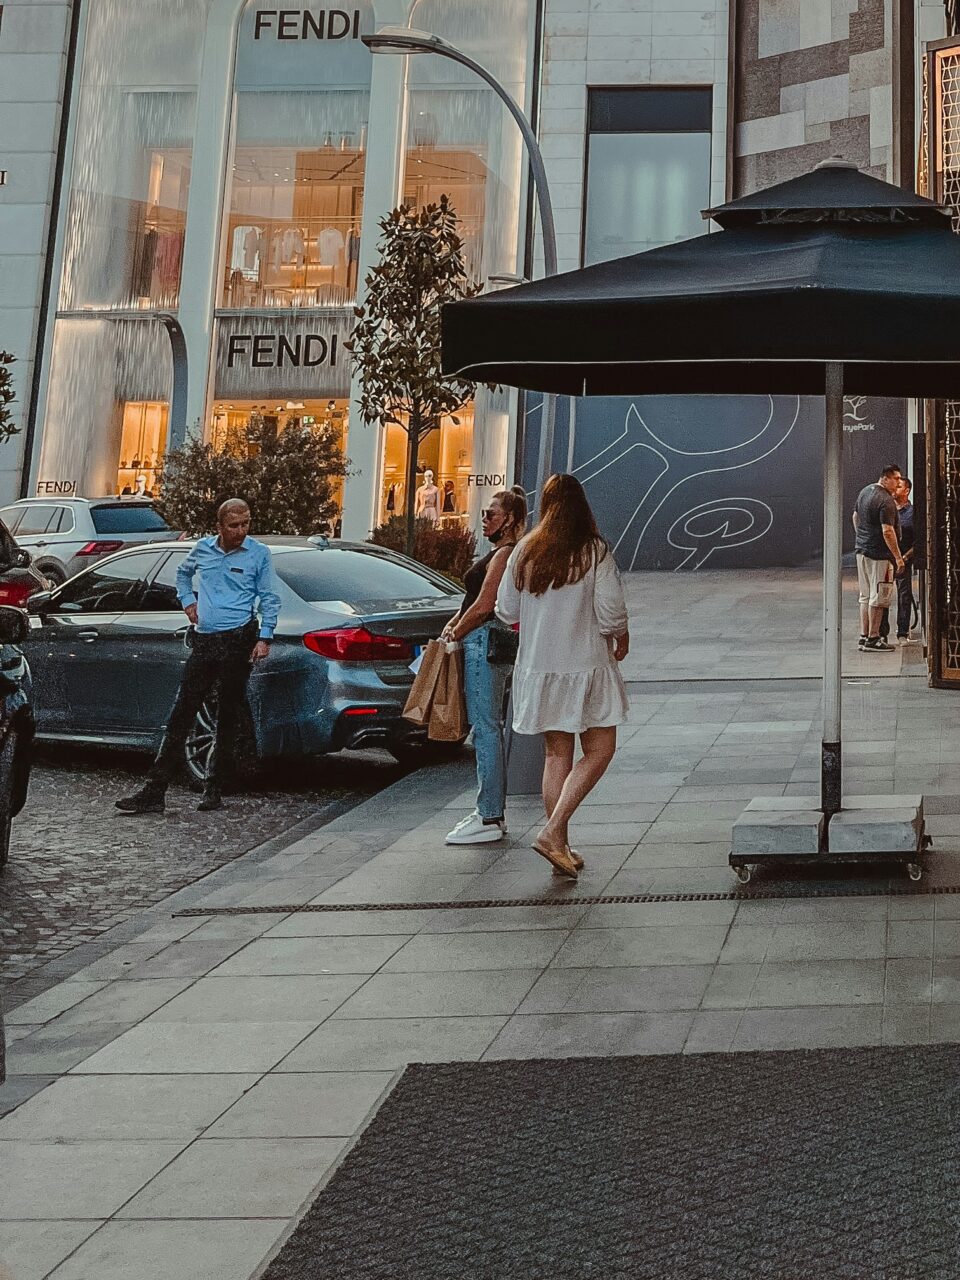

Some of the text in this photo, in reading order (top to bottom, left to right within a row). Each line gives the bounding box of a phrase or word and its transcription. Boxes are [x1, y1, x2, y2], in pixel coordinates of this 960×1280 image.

[254, 10, 360, 40] FENDI
[227, 334, 338, 368] FENDI
[37, 480, 77, 494] FENDI
[467, 474, 506, 487] FENDI
